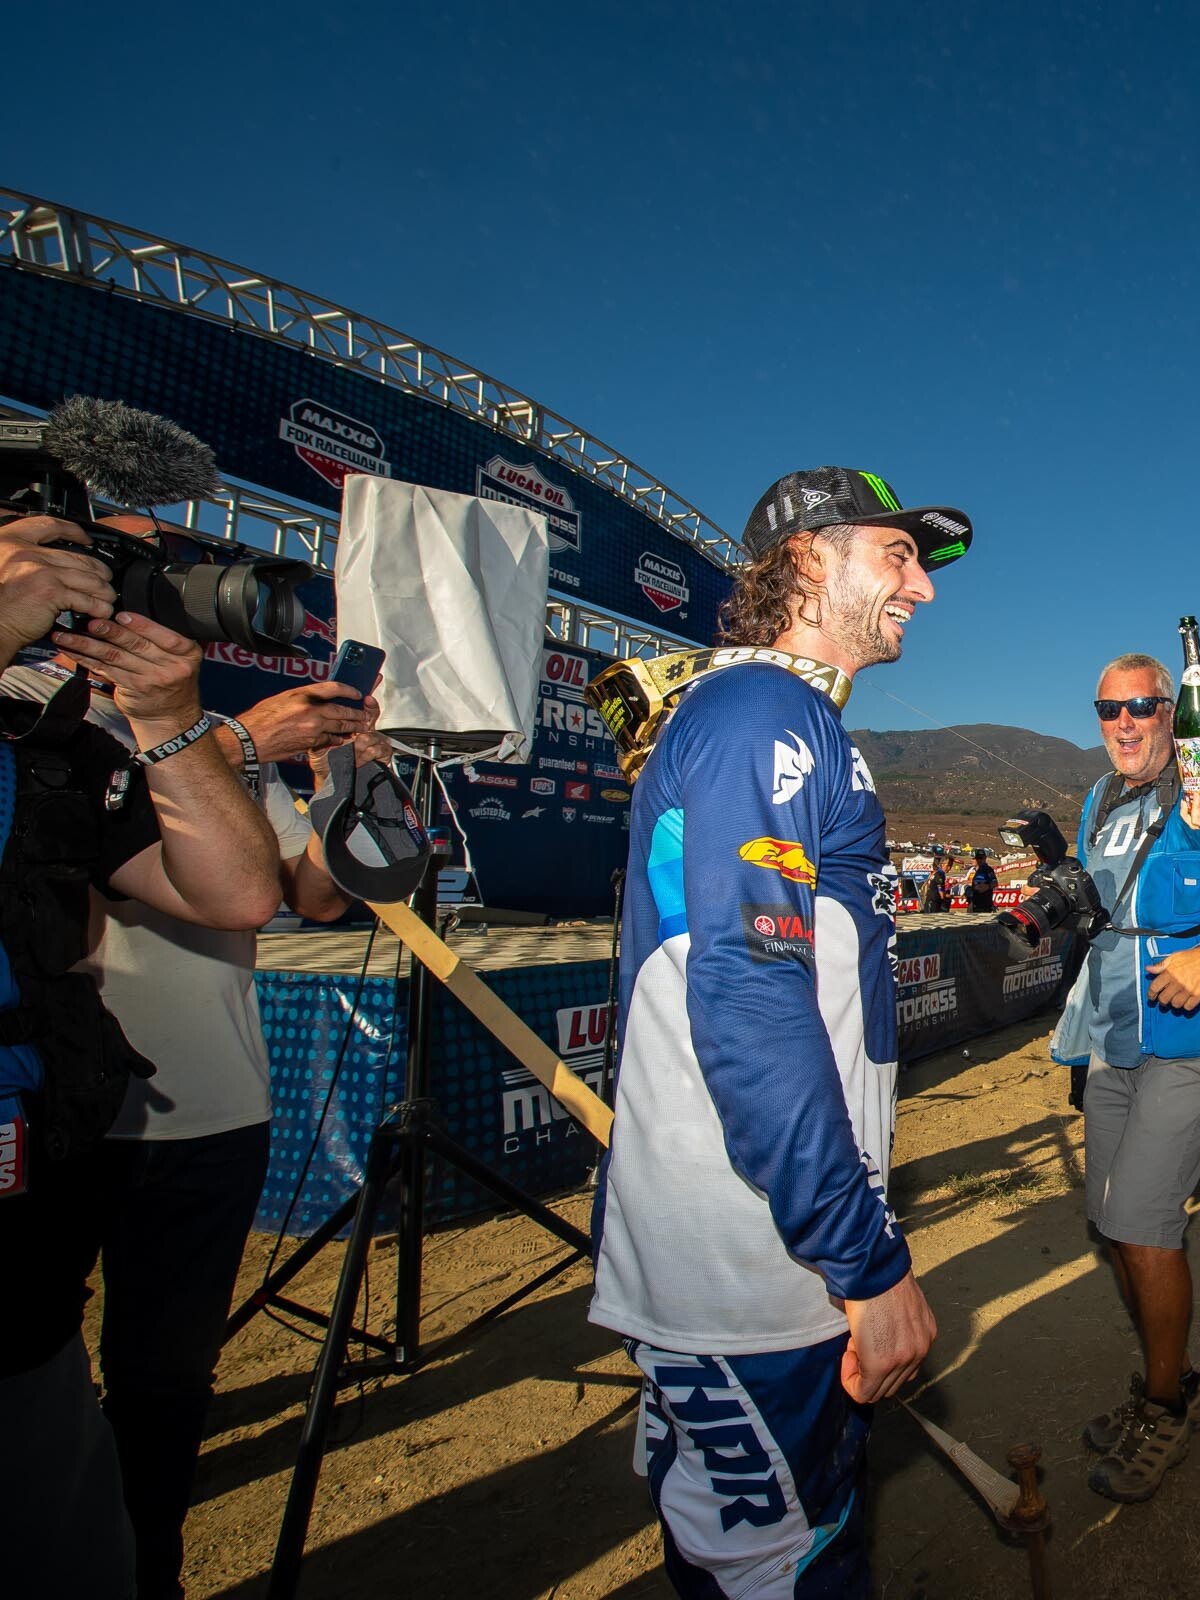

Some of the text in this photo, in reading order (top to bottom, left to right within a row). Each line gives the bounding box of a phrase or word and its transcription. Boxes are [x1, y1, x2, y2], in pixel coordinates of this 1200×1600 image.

[301, 408, 377, 449] MAXXIS
[286, 425, 313, 447] FOX
[315, 437, 377, 472] RACEWAY
[306, 452, 361, 475] NATION
[497, 466, 565, 507] LUCAS OIL
[932, 515, 969, 536] YAMAHA
[638, 572, 650, 584] FOX
[644, 559, 681, 581] MAXXIS
[546, 654, 585, 687] OIL
[153, 737, 187, 759] FOX
[243, 740, 257, 761] FOX
[539, 757, 576, 771] guaranteed
[478, 775, 518, 787] ASGAS
[468, 807, 498, 818] TWISTED
[497, 808, 511, 821] TEA
[898, 955, 938, 985] CAS OIL
[1003, 962, 1063, 994] MOTOCROSS
[896, 987, 957, 1026] TOCROSS
